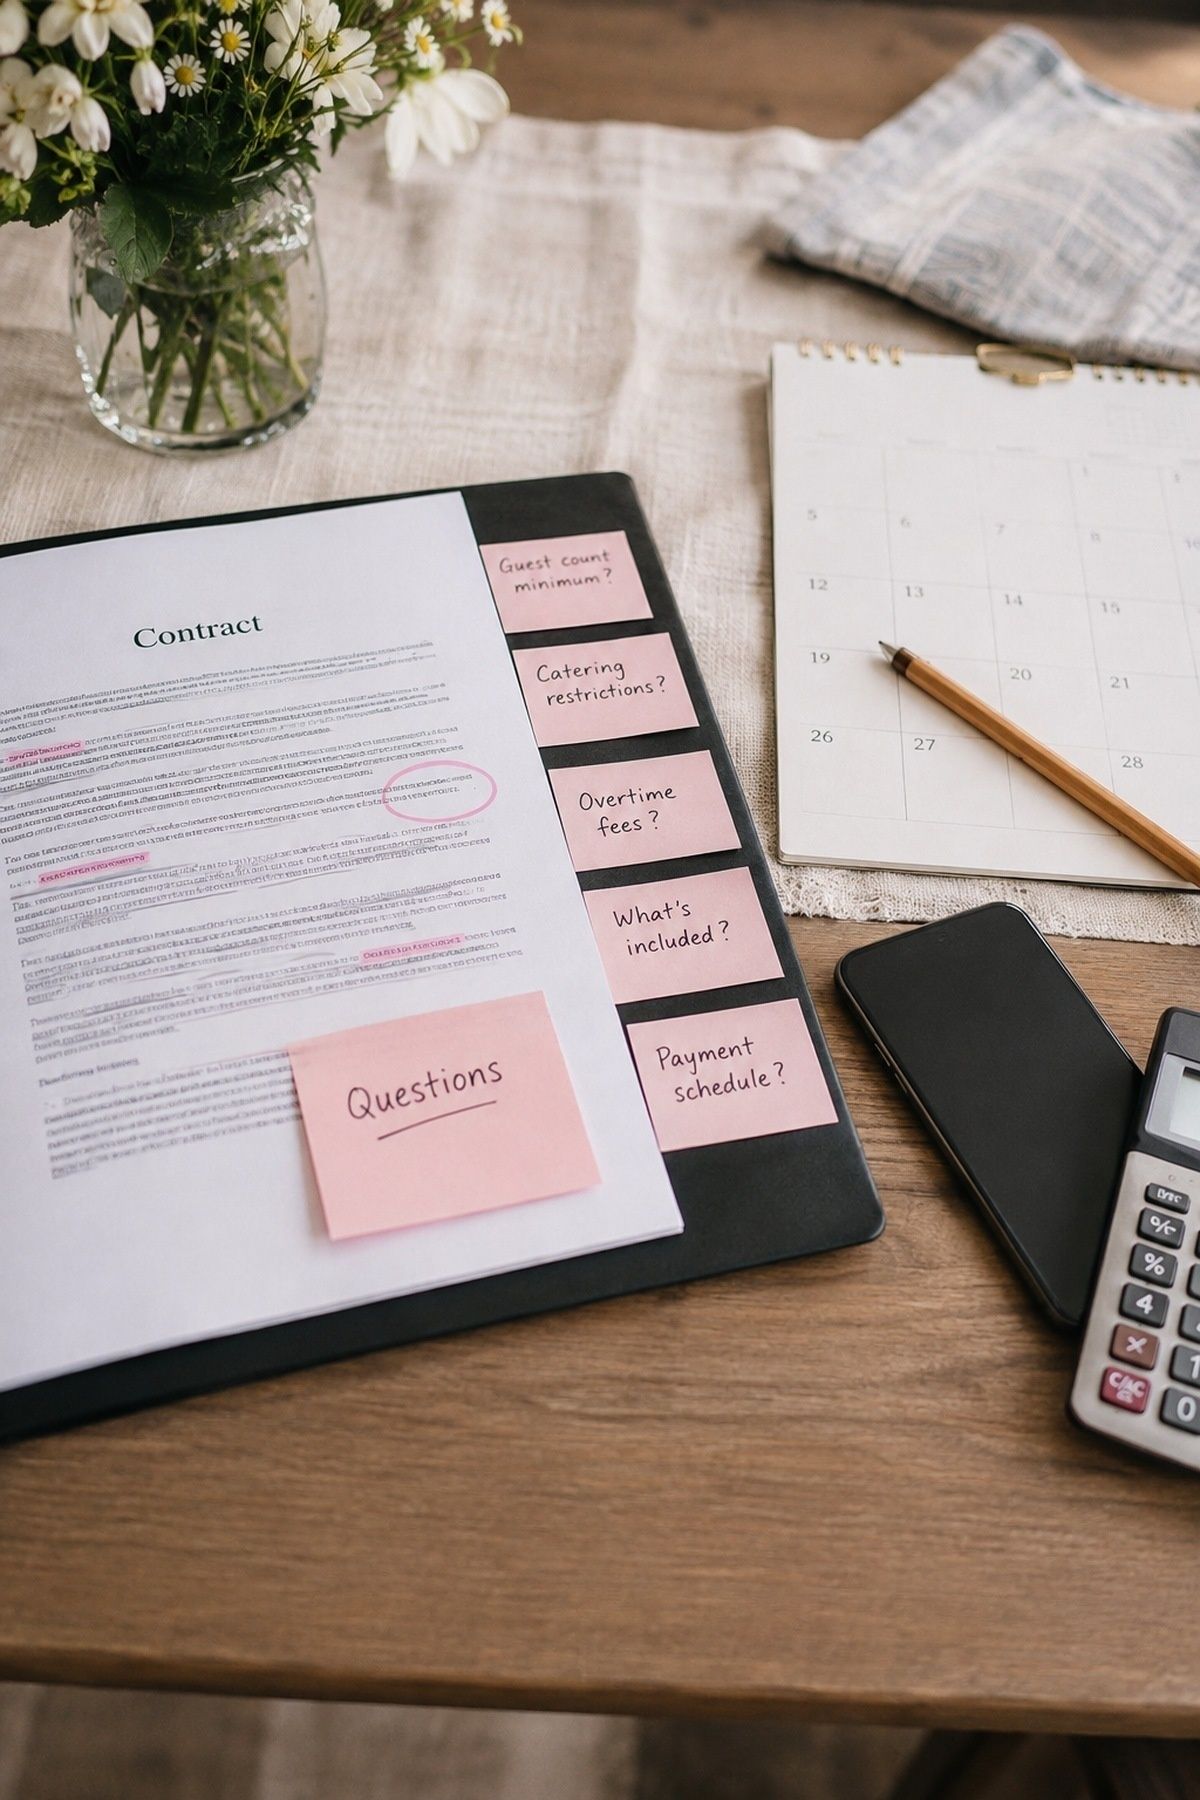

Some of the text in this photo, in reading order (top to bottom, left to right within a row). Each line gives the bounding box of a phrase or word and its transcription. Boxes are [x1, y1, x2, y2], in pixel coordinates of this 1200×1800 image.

[499, 550, 611, 574] Guest count
[809, 578, 829, 592] 12
[905, 585, 925, 599] 13
[1004, 592, 1024, 607] 14
[1101, 601, 1121, 615] 15
[133, 614, 264, 649] Contract
[811, 651, 831, 665] 19
[537, 661, 626, 684] Catering
[1010, 667, 1033, 681] 20
[1111, 676, 1130, 690] 21
[810, 729, 834, 744] 26
[914, 737, 936, 751] 27
[1121, 755, 1144, 769] 28
[578, 785, 677, 811] Overtime
[612, 900, 692, 929] What's
[656, 1036, 755, 1075] Payment
[348, 1059, 503, 1120] Questions
[1136, 1294, 1153, 1315] 4
[1177, 1396, 1197, 1422] 0
